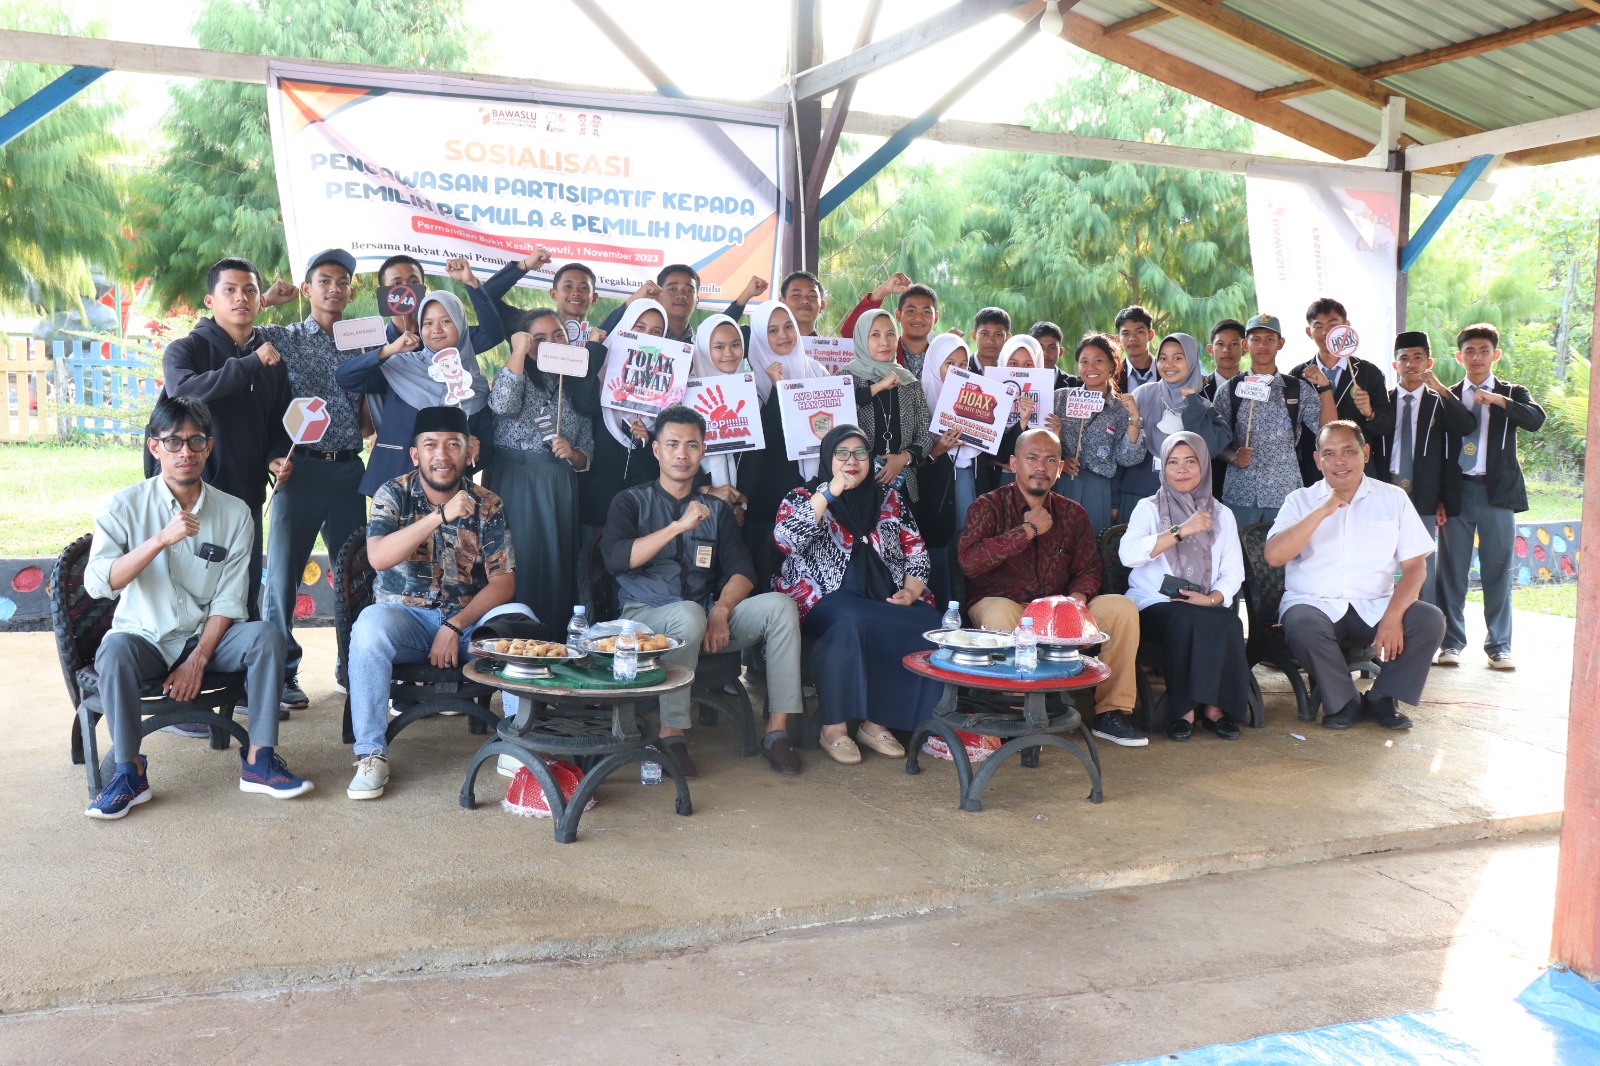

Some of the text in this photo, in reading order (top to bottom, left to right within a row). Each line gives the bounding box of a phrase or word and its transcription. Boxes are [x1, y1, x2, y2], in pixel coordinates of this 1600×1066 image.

[492, 109, 537, 121] BAWASLU
[445, 140, 630, 177] SOSIALISASI
[310, 153, 755, 216] PENGAWASAN PARTISIPATIF KEPADA
[325, 181, 743, 244] PEMILIH PEMULA & PEMILIH MUDA
[417, 220, 477, 240] Permandian
[479, 235, 503, 247] Bukit
[506, 240, 533, 251] Kasih
[583, 247, 632, 261] November
[634, 253, 659, 264] 2023
[351, 241, 400, 251] Bersama
[403, 244, 440, 258] Rakyat
[442, 250, 472, 261] Awasi
[598, 276, 643, 288] Tegakkan
[700, 285, 720, 293] milu
[387, 293, 415, 306] SARA
[1332, 330, 1357, 352] HOAX
[627, 348, 675, 374] TOLAK
[624, 367, 671, 392] LAWAN
[793, 389, 844, 402] AYO KAWAL
[958, 389, 992, 410] HOAX
[1070, 390, 1100, 399] AYO!!!
[798, 399, 841, 410] HAK PILIH
[1068, 402, 1102, 411] PEMILU
[706, 417, 748, 430] TOP!!!!!!!
[953, 416, 975, 429] LAWAN
[719, 427, 751, 439] SARA
